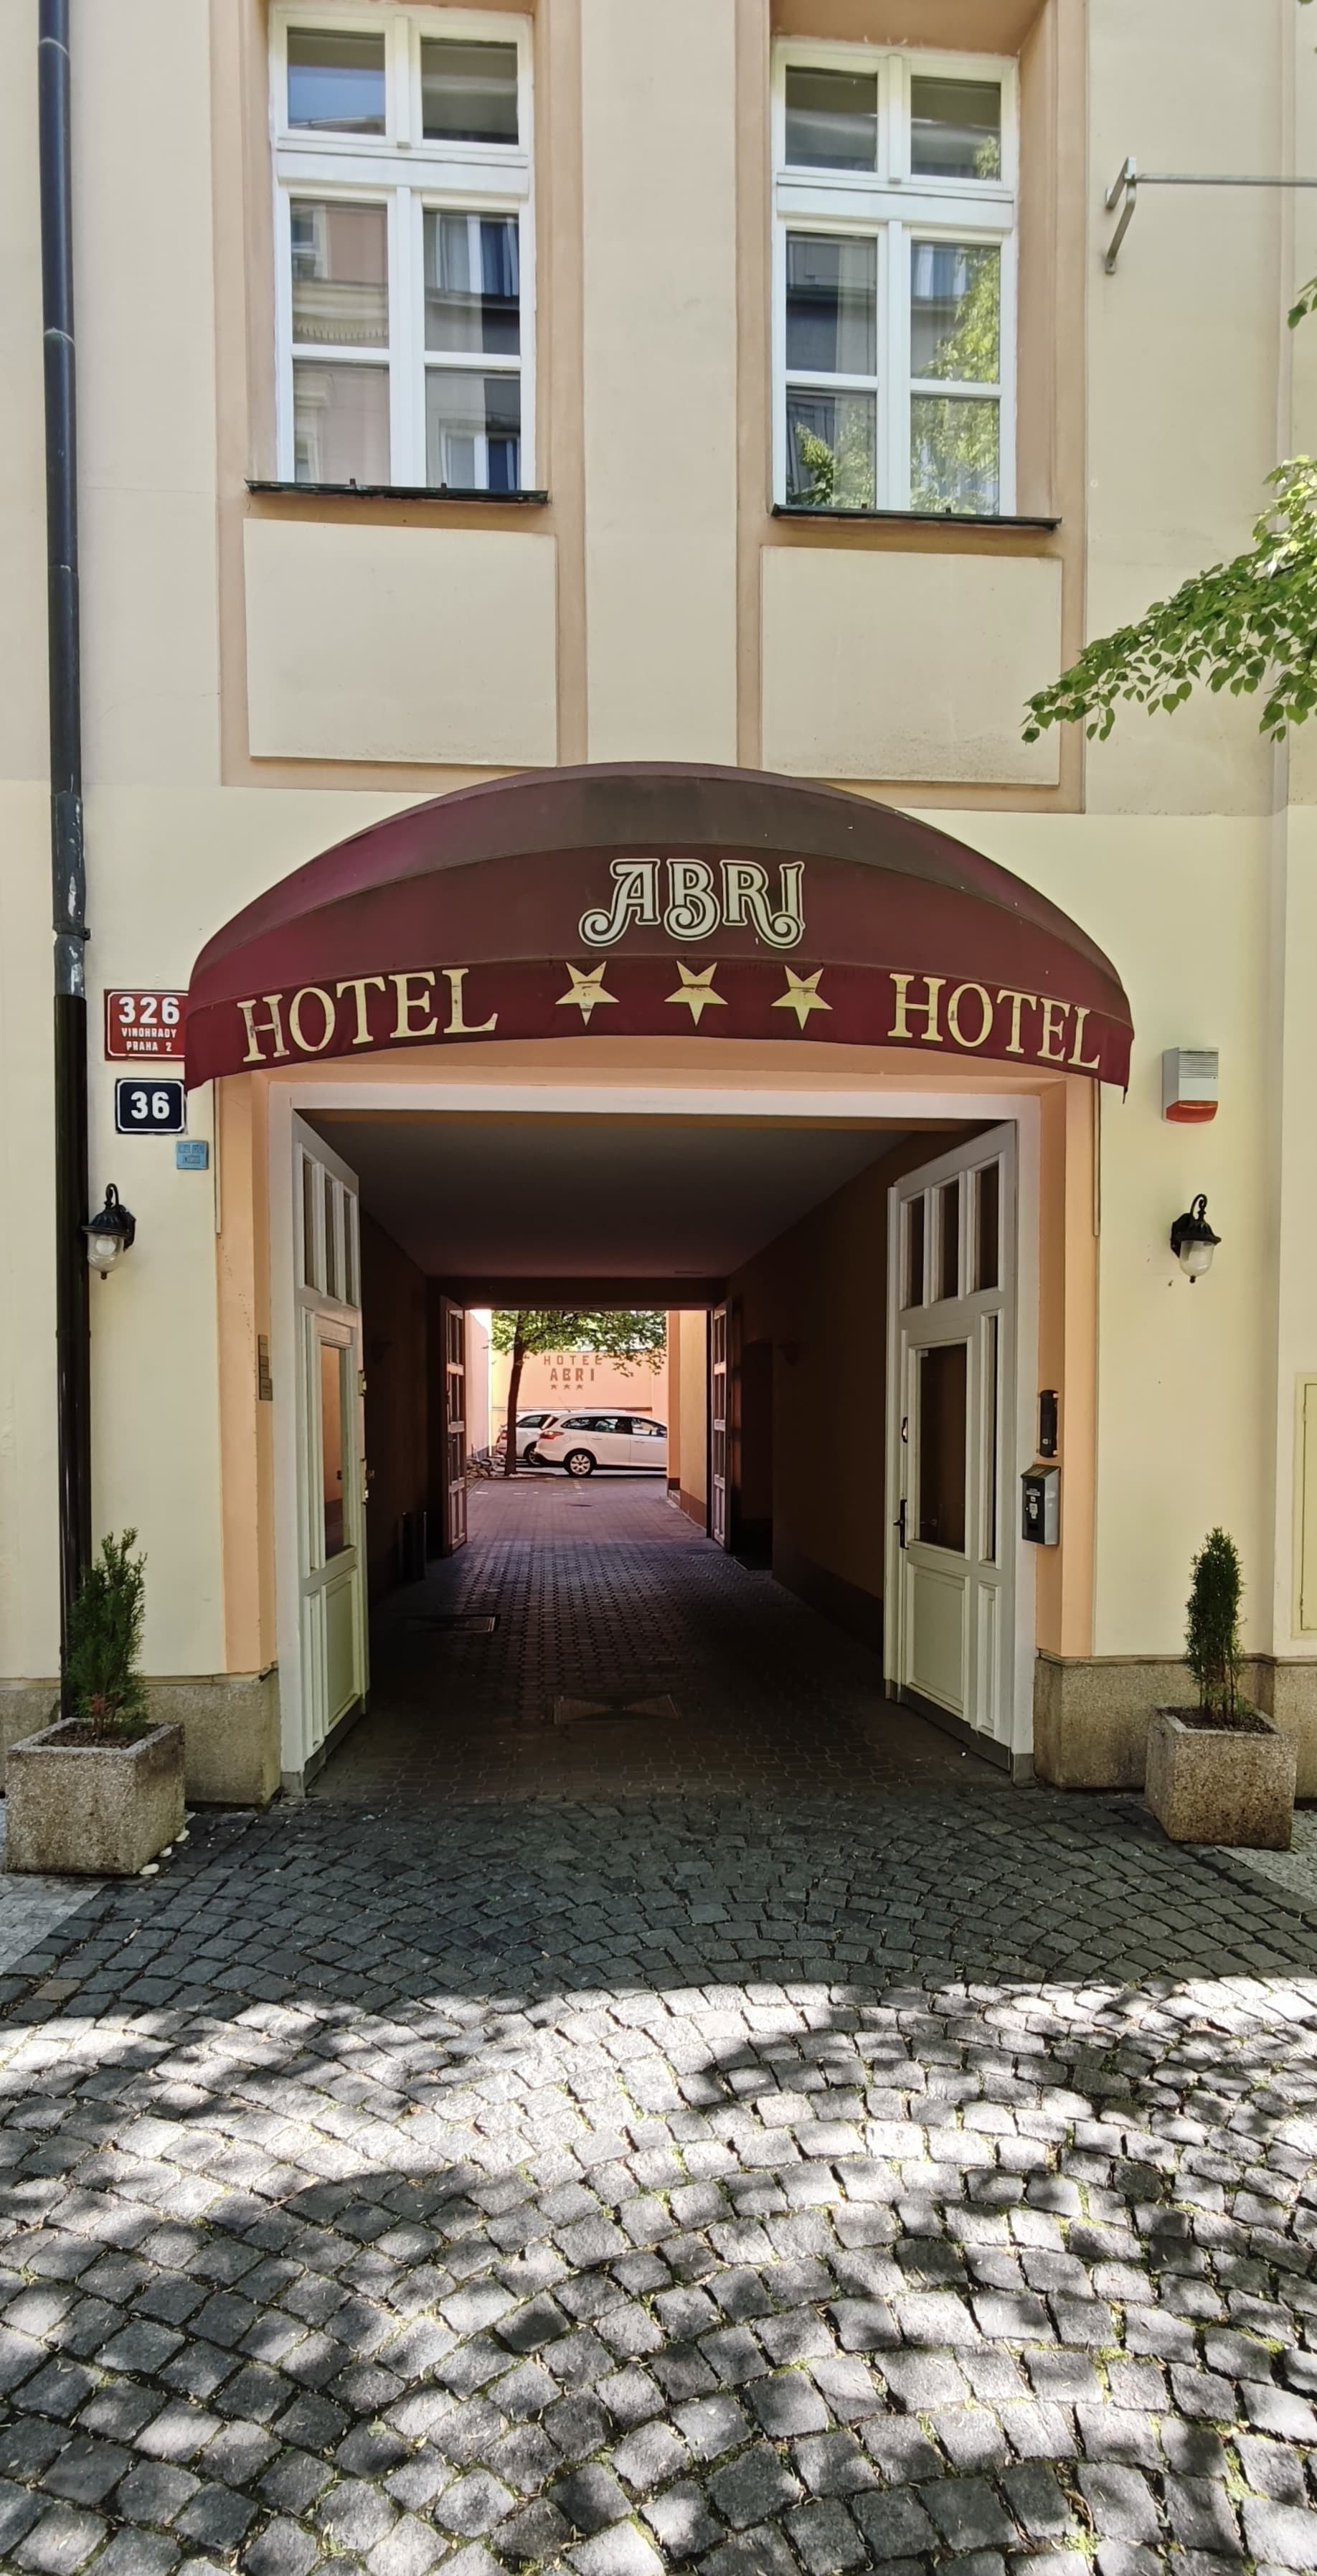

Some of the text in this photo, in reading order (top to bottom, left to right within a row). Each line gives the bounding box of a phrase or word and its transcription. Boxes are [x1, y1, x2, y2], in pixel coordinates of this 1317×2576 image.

[578, 857, 806, 949] ABRI
[118, 996, 180, 1025] 326
[237, 967, 1101, 1069] HOTEL HOTEL
[121, 1027, 177, 1038] VINOHRADY
[126, 1040, 172, 1052] PRAHA 2
[131, 1091, 170, 1119] 36
[544, 1355, 603, 1365] HOTEL
[550, 1368, 595, 1381] ABRI
